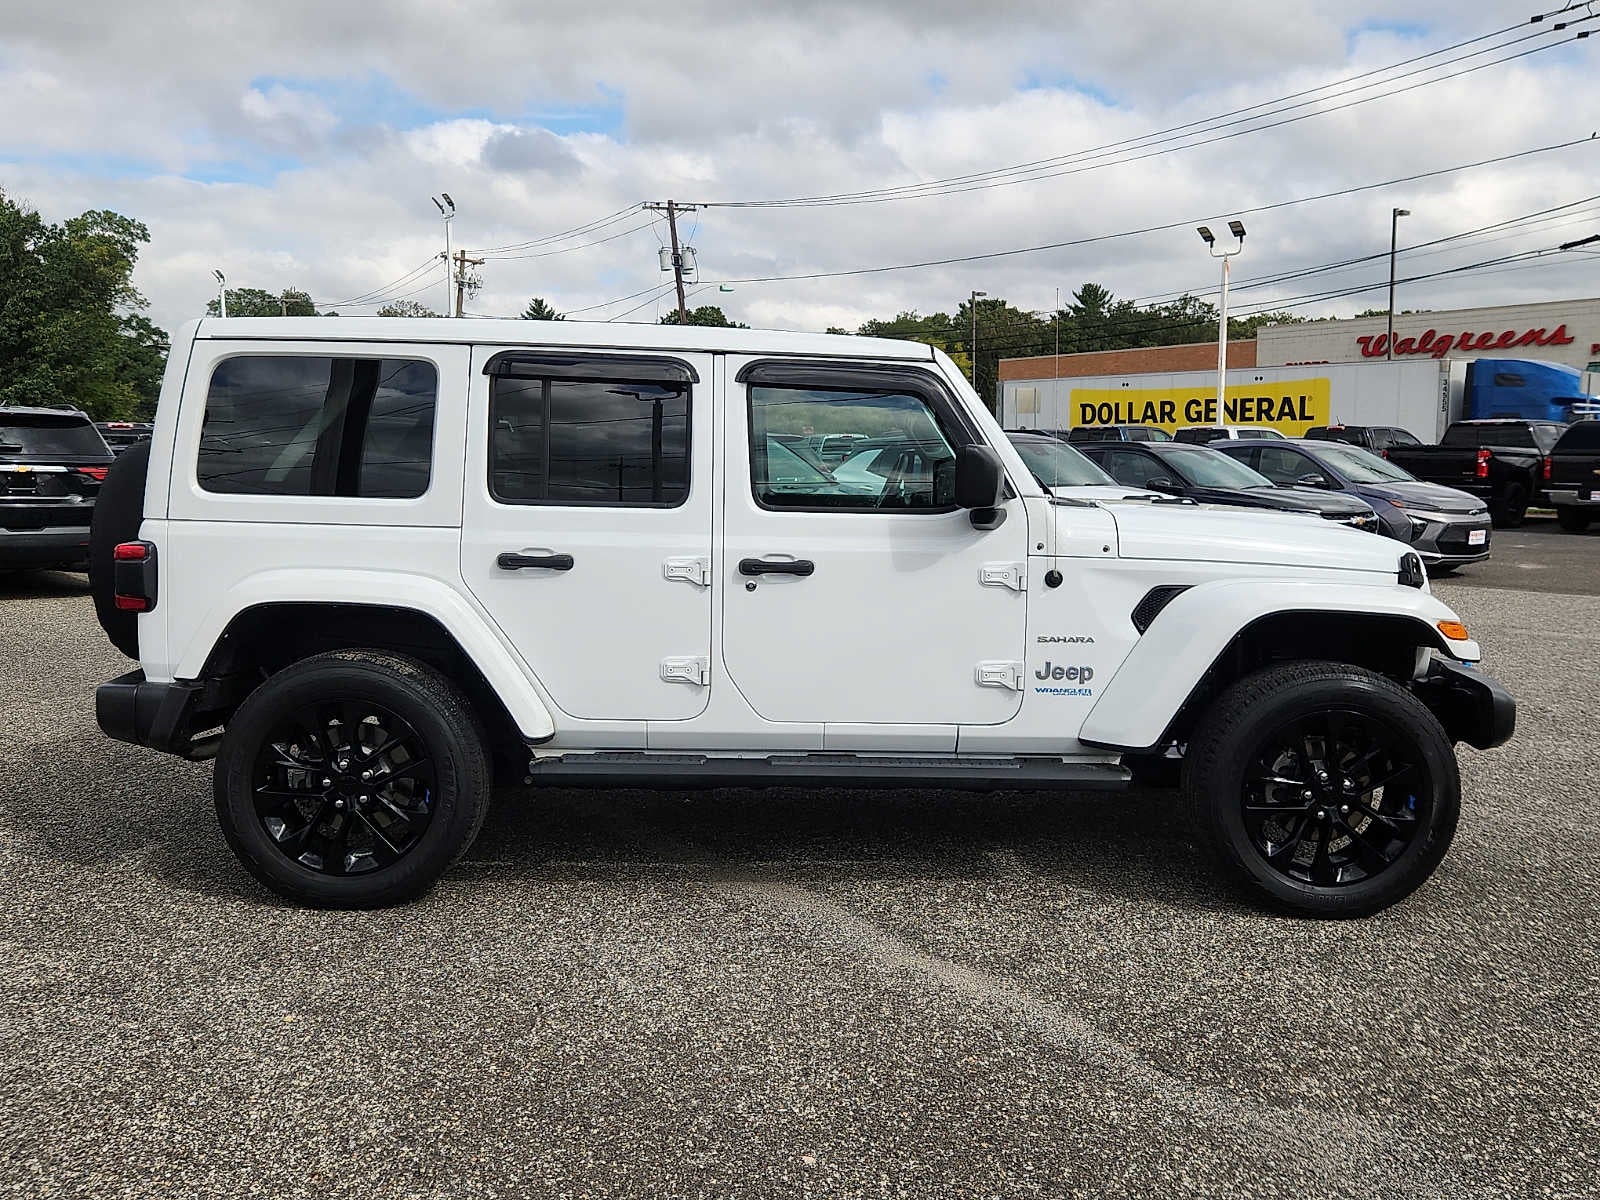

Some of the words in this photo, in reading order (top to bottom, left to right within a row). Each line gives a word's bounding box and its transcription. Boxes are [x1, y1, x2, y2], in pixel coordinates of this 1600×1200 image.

[1356, 324, 1575, 359] Walgreens
[1080, 400, 1177, 425] DOLLAR
[1184, 395, 1315, 423] GENERAL
[1036, 636, 1095, 644] SAHARA
[1035, 661, 1094, 685] Jeep
